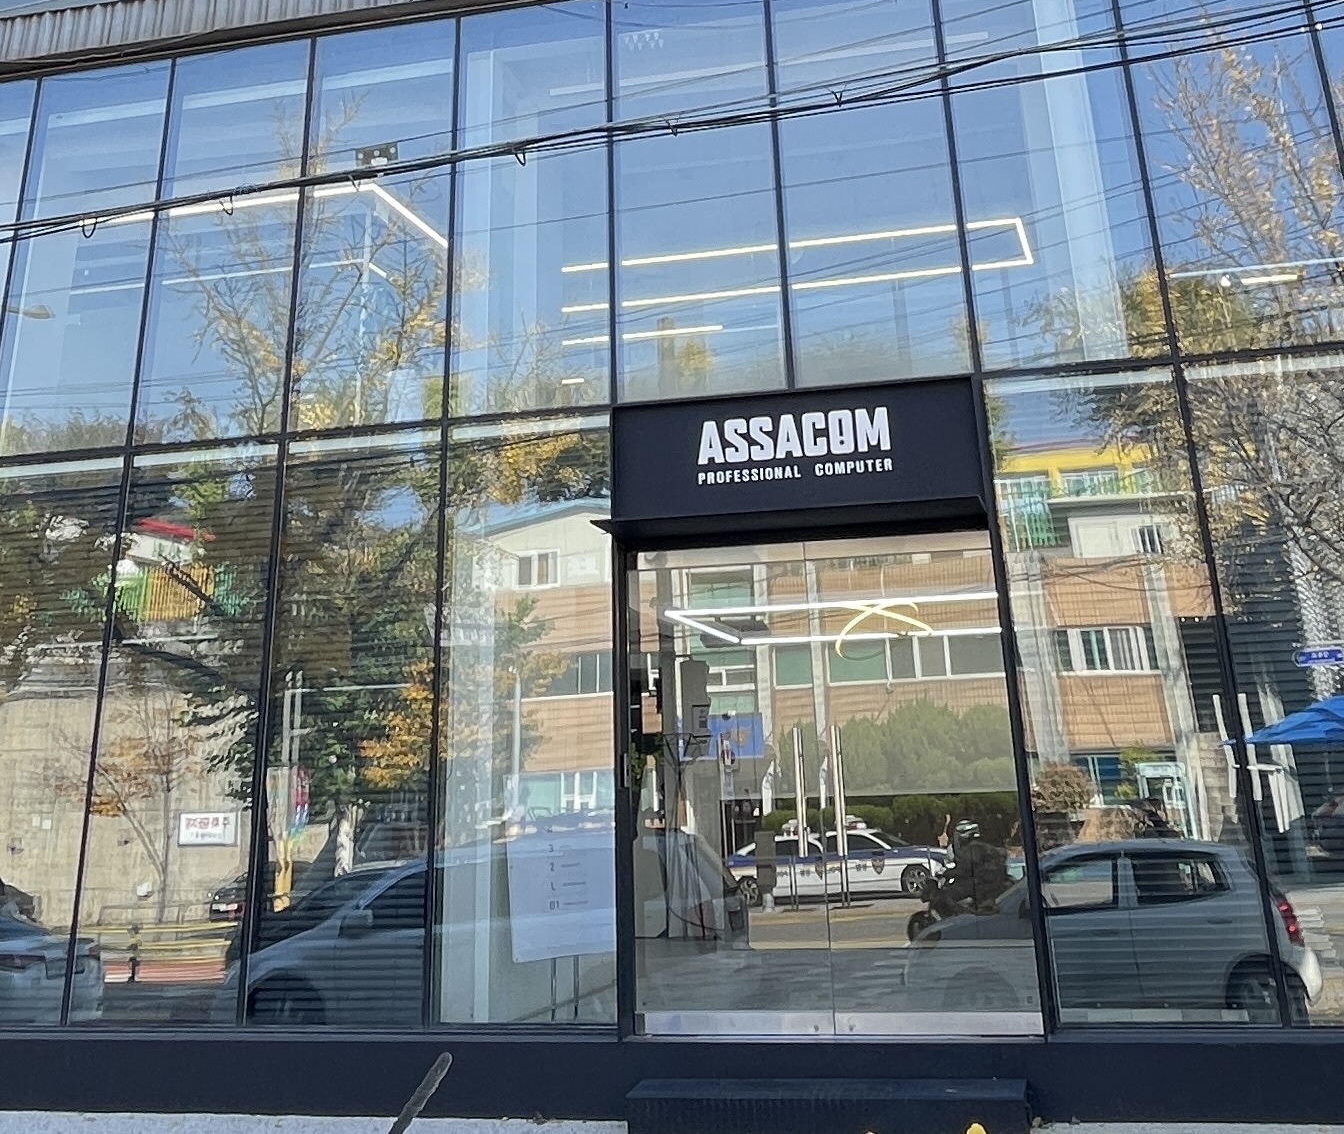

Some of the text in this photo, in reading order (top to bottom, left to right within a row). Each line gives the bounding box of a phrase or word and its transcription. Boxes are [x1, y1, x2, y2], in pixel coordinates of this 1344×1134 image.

[697, 406, 891, 465] ASSACOM
[697, 458, 894, 485] PROFESSIONAL COMPUTER
